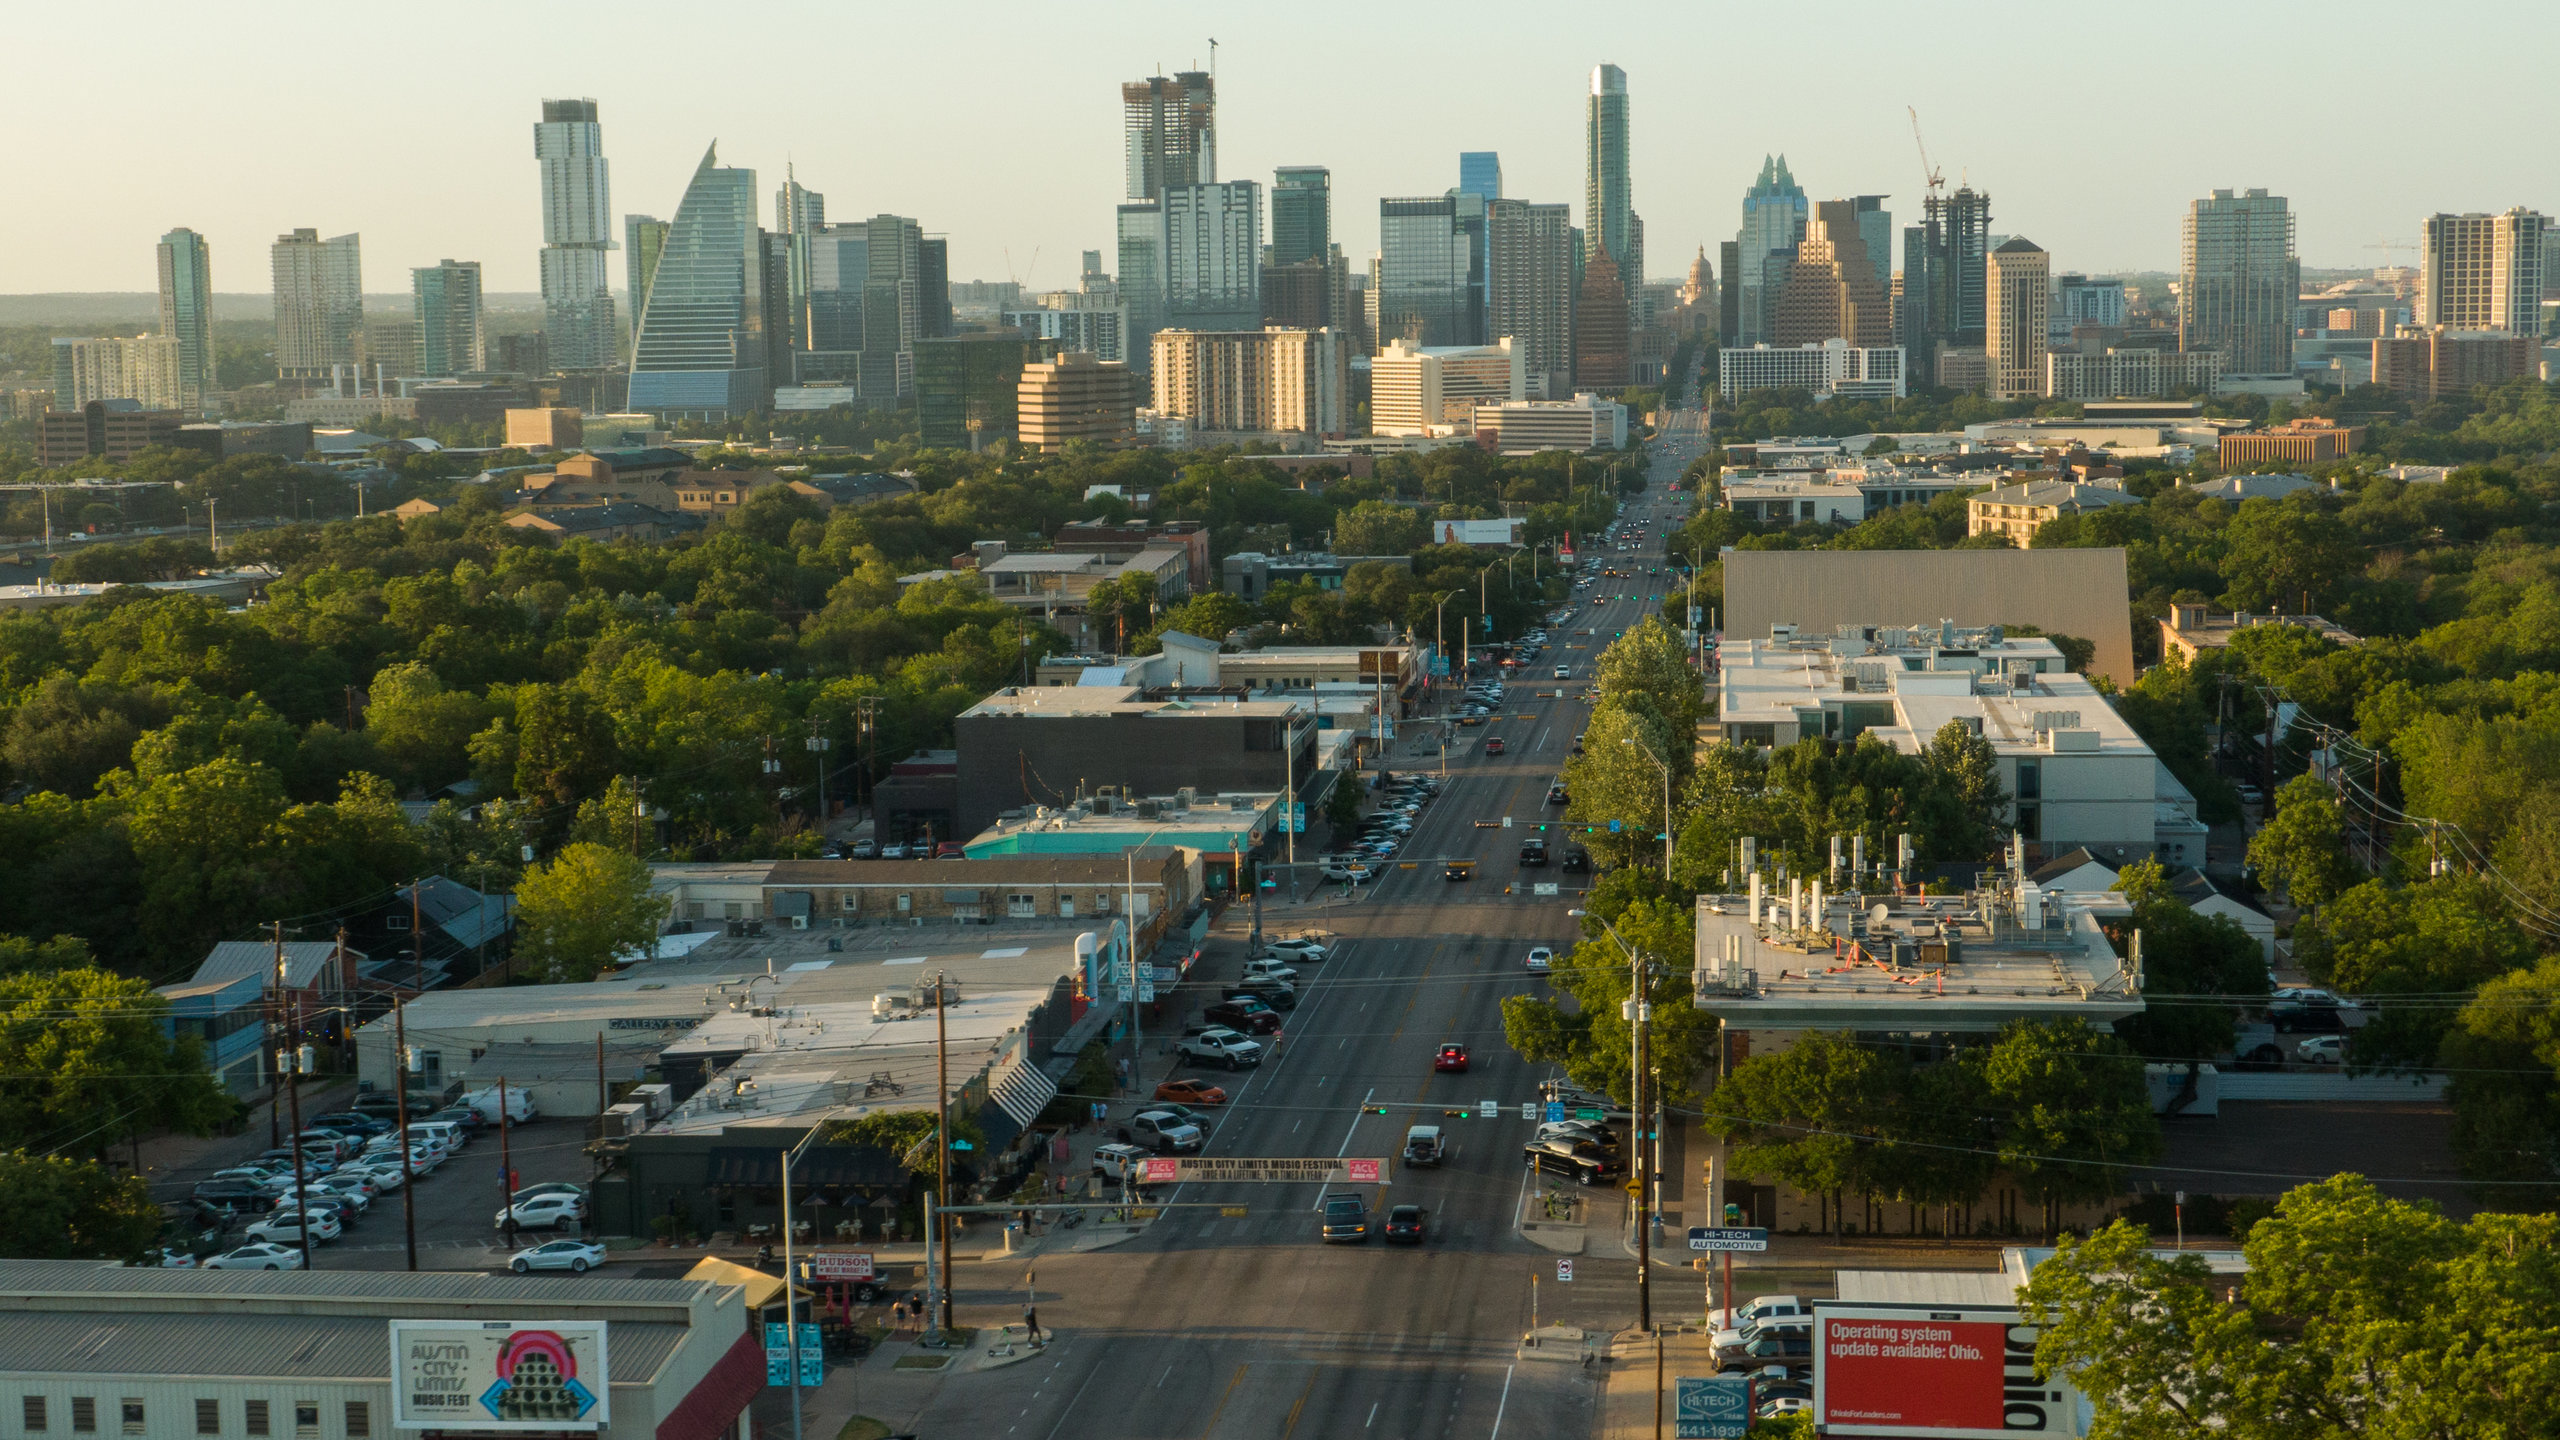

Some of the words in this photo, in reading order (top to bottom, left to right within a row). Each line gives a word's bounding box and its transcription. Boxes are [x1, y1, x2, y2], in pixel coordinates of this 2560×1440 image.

[610, 1020, 666, 1029] GALLERY
[1181, 1160, 1213, 1168] AUSTIN
[1216, 1160, 1235, 1169] CITY
[1238, 1160, 1268, 1169] LIMITS
[1271, 1160, 1300, 1169] MUSIC
[1303, 1160, 1344, 1169] FESTIVAL
[1354, 1164, 1373, 1172] ACL
[1228, 1170, 1232, 1180] A
[1264, 1170, 1278, 1180] TWO
[1280, 1170, 1298, 1180] TIMES
[1300, 1170, 1305, 1180] A
[1307, 1170, 1322, 1180] YEAR
[1704, 1230, 1750, 1239] HI-TECH
[1693, 1241, 1762, 1249] AUTOMOTIVE
[818, 1258, 869, 1266] HUDSON
[1831, 1323, 1898, 1342] Operating
[1901, 1326, 1951, 1343] system
[411, 1345, 469, 1360] AUSTIN
[1831, 1342, 1878, 1358] update
[1882, 1343, 1946, 1358] available:
[1949, 1344, 1984, 1360] Ohio.
[422, 1361, 458, 1376] CITY
[415, 1376, 466, 1391] LIMITS
[413, 1394, 445, 1406] MUSIC
[448, 1394, 470, 1406] FEST
[1680, 1426, 1745, 1437] 441-1933
